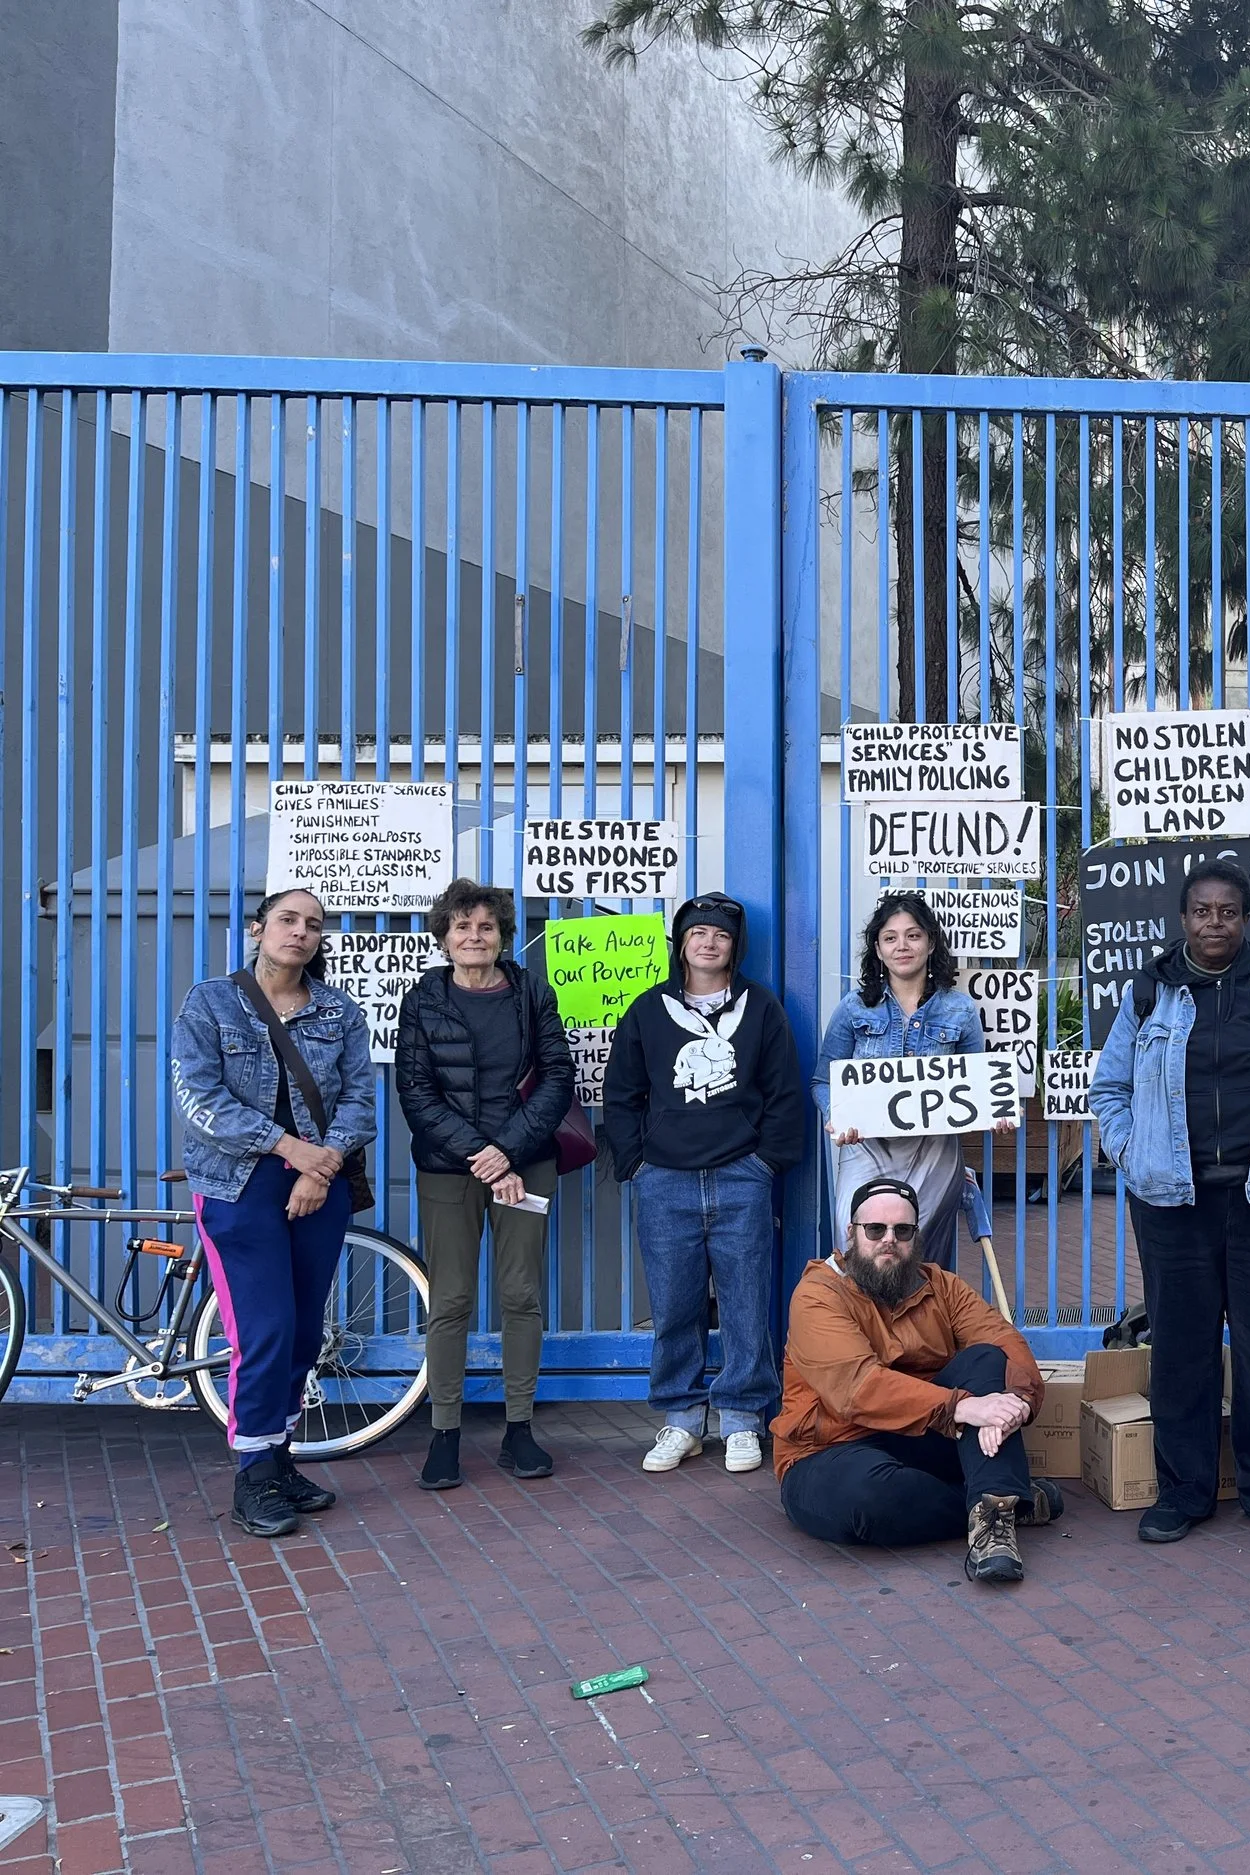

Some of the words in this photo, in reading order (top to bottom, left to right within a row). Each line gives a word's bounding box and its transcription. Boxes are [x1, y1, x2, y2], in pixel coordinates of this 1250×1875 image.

[909, 725, 1019, 742] PROTECTIVE
[1116, 726, 1149, 750] NO
[1154, 720, 1246, 750] STOLEN
[963, 742, 986, 762] IS
[848, 766, 912, 792] FAMILY
[919, 765, 1010, 791] POLICING
[275, 784, 314, 795] CHILD
[394, 785, 447, 797] SERVICES
[1117, 786, 1149, 806] ON
[1154, 783, 1244, 805] STOLEN
[275, 798, 312, 811] GIVES
[296, 815, 380, 828] PUNISHMENT
[1144, 808, 1226, 833] LAND
[293, 832, 349, 844] SHIFTING
[352, 831, 422, 844] GOALPOSTS
[528, 821, 575, 840] THE
[578, 821, 661, 841] STATE
[869, 806, 1034, 858] DEFUND!
[295, 849, 360, 861] IMPOSSIBLE
[364, 849, 441, 863] STANDARDS
[527, 845, 678, 868] ABANDONED
[357, 864, 432, 880] CLASSISM,
[869, 861, 909, 874] CHILD
[987, 861, 1036, 874] SERVICES
[1086, 857, 1166, 890] JOIN
[320, 880, 389, 893] ABLEISM
[537, 871, 574, 894] US
[586, 871, 666, 894] FIRST
[931, 891, 1019, 908] INDIGENOUS
[1086, 917, 1166, 946] STOLEN
[550, 931, 596, 956] Take
[605, 930, 655, 957] Away
[375, 954, 428, 974] CARE
[592, 959, 662, 988] Poverty
[968, 972, 1033, 1002] COPS
[602, 990, 630, 1006] not
[1049, 1050, 1093, 1069] KEEP
[841, 1056, 968, 1086] ABOLISH
[888, 1084, 979, 1131] CPS
